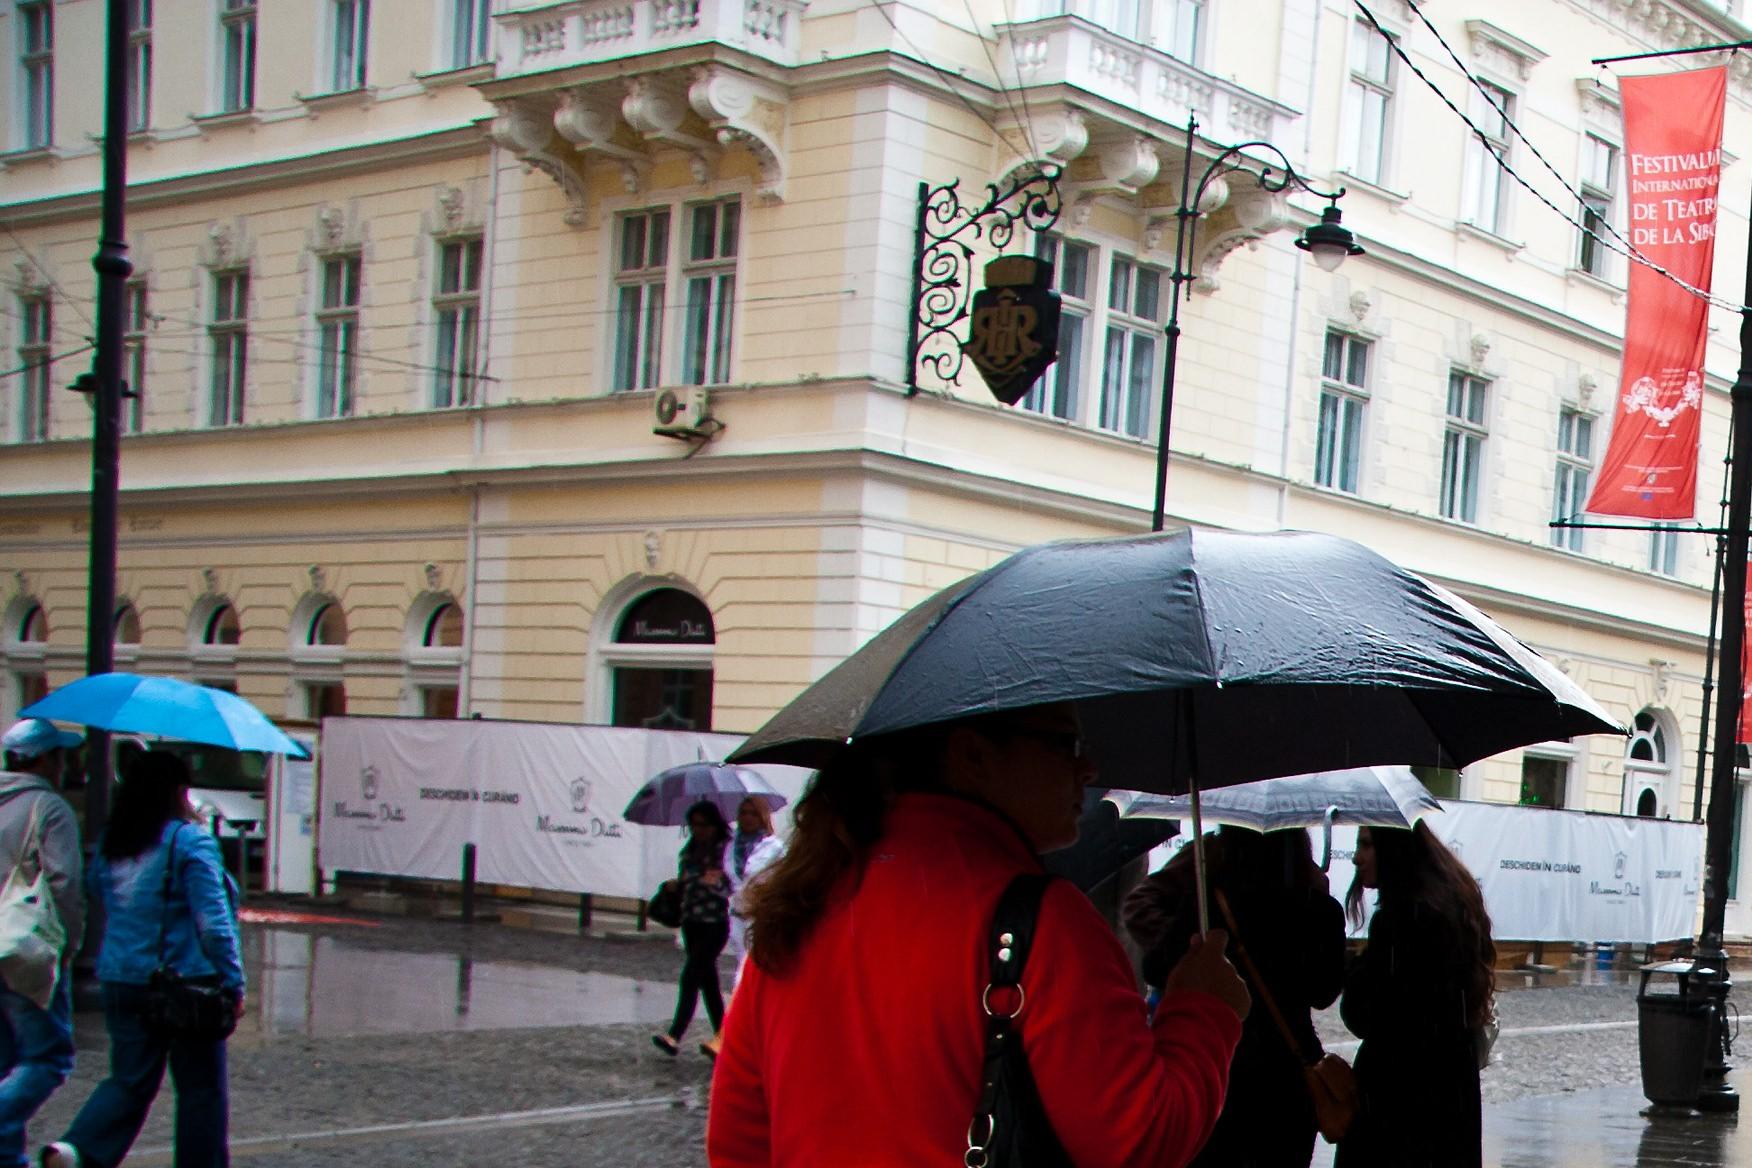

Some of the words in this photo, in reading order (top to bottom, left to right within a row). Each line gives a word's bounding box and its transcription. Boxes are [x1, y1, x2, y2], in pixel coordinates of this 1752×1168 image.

[1633, 203, 1657, 220] DE
[1634, 228, 1657, 245] DE
[1663, 228, 1684, 244] LA
